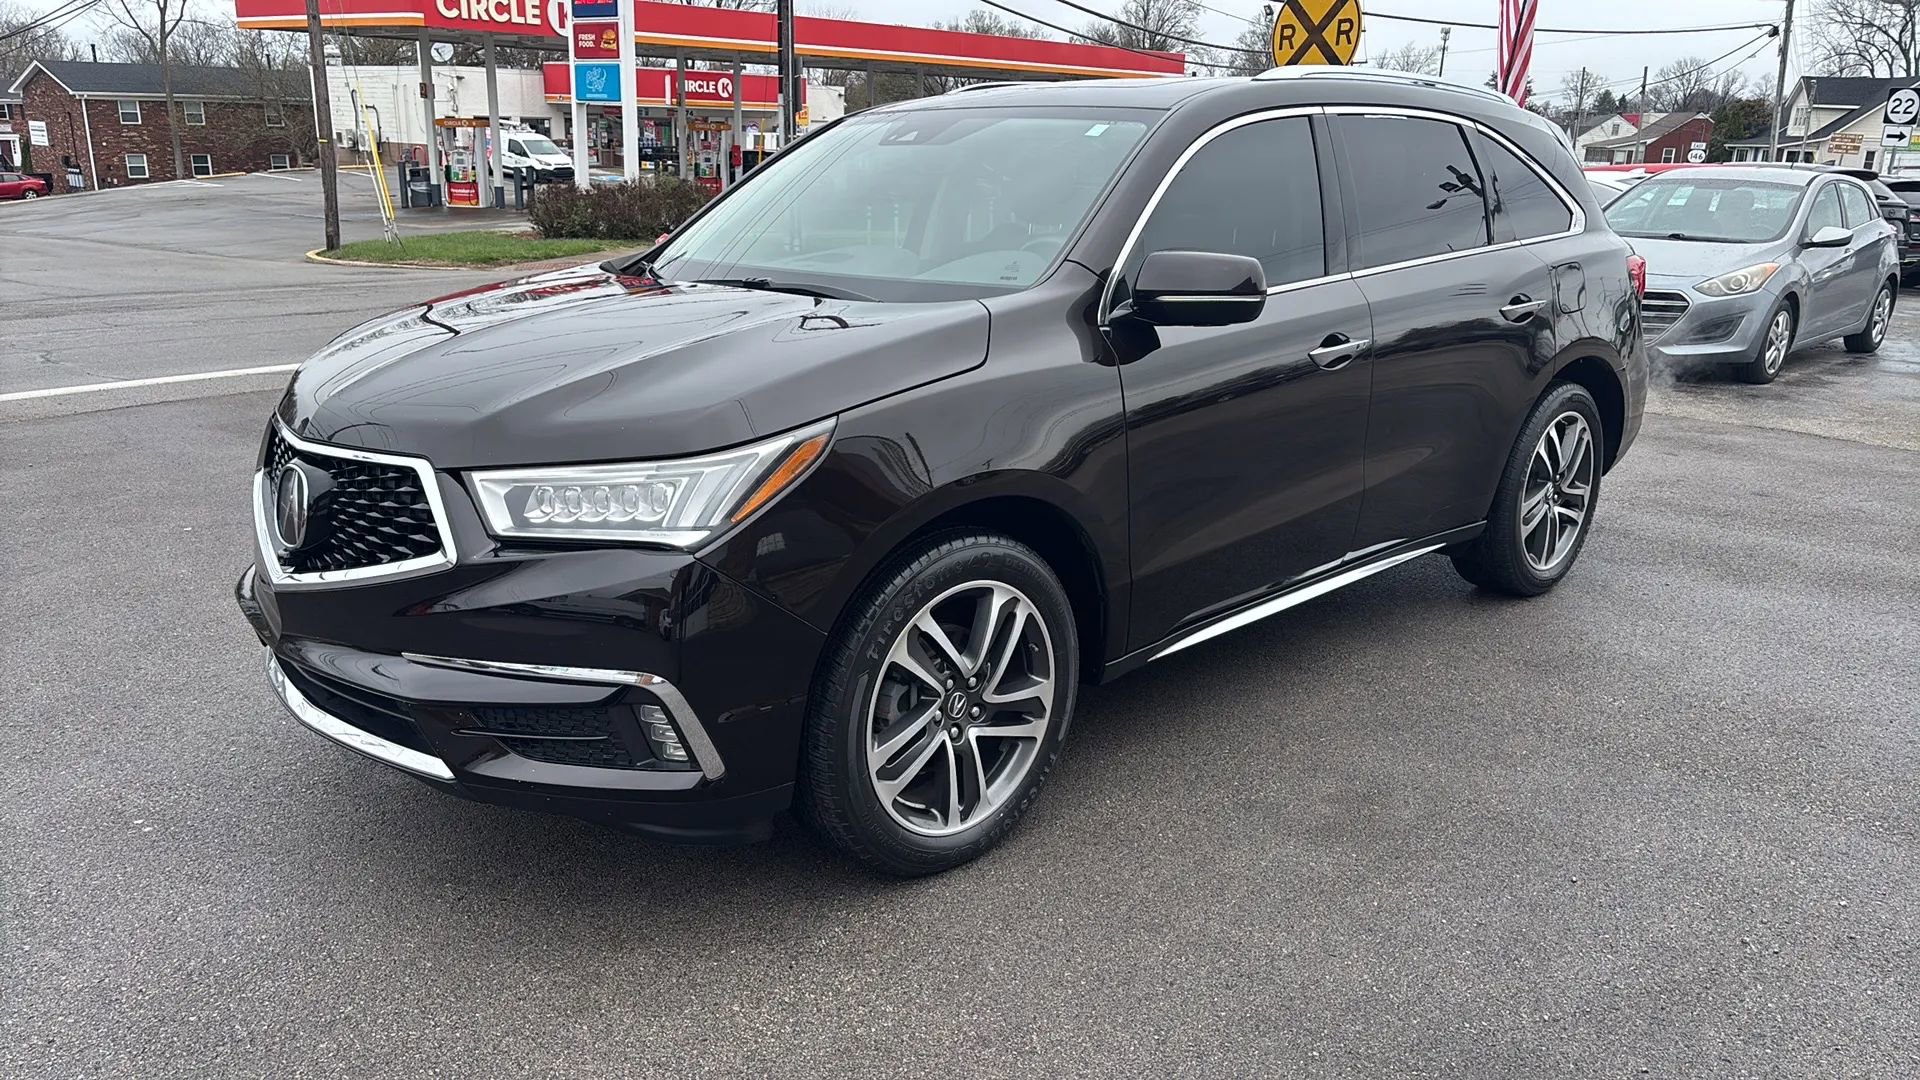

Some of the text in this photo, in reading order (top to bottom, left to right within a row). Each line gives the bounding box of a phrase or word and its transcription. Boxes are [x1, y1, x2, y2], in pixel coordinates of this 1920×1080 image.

[436, 0, 541, 25] CIRCLE
[578, 33, 596, 41] FRESH
[1279, 18, 1354, 50] R R
[676, 79, 716, 93] IRCLE
[1890, 98, 1915, 114] 22
[1690, 152, 1703, 161] 146
